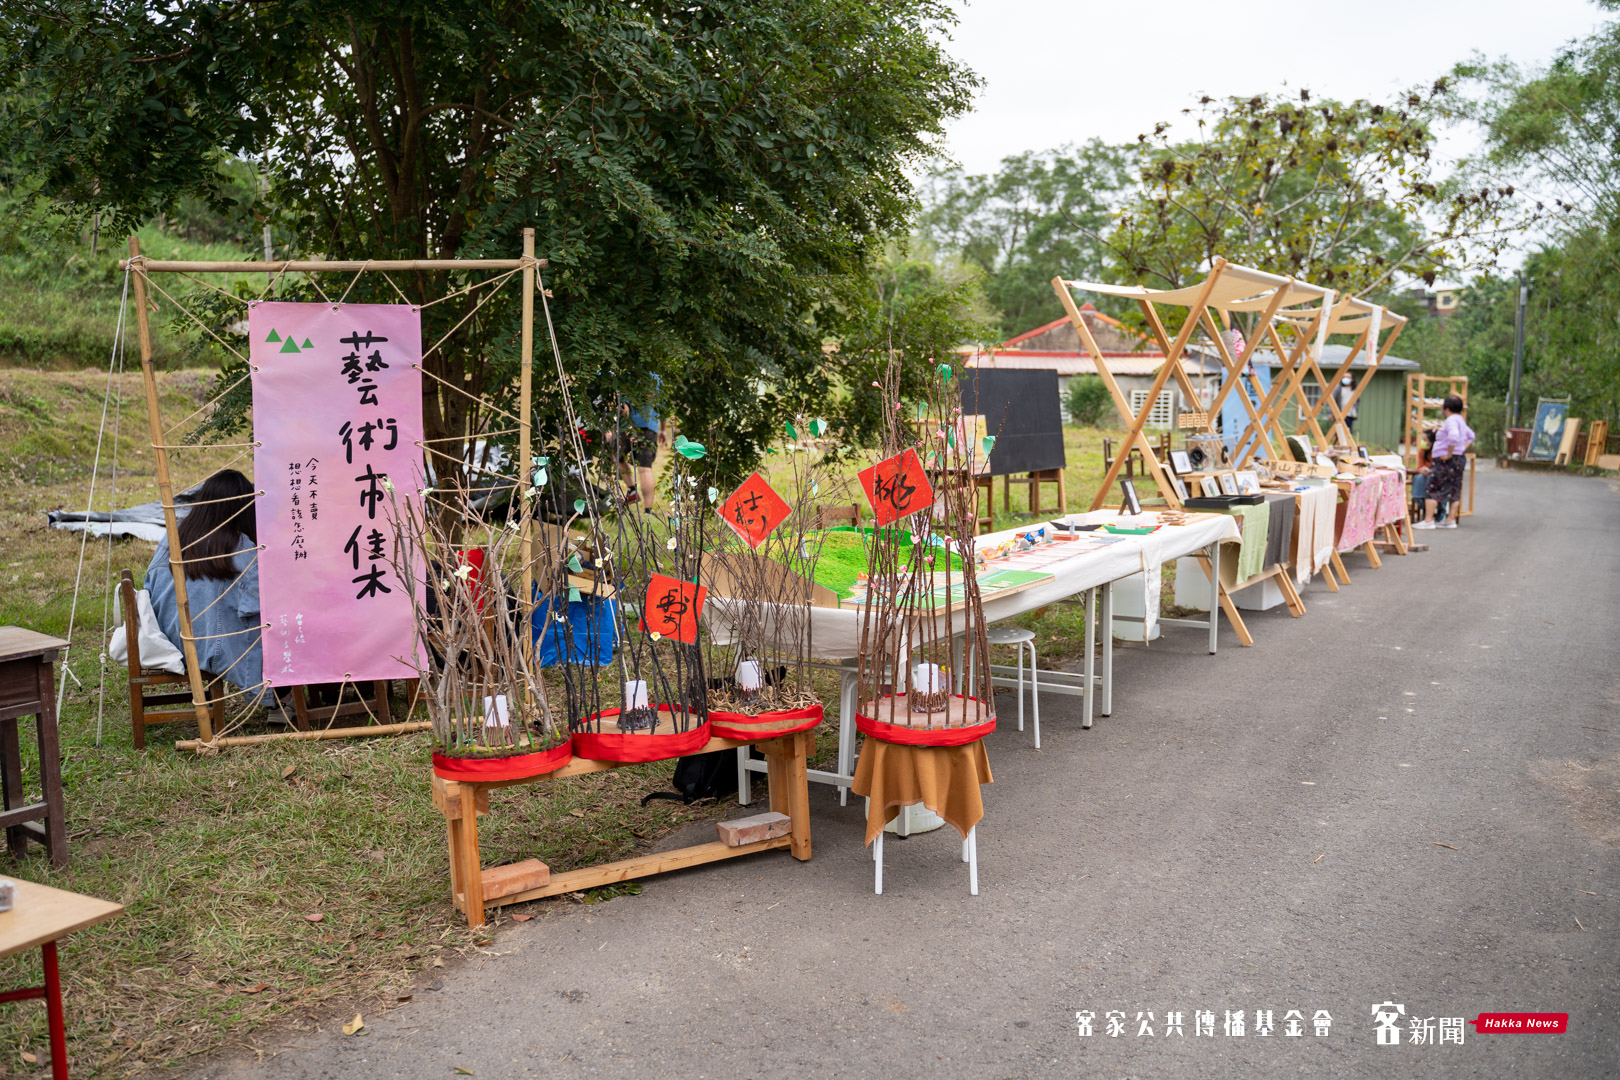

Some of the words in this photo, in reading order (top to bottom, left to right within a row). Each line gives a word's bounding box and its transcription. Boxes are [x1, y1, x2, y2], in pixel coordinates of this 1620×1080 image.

[288, 462, 308, 561] 想想看該怎麼辦
[305, 457, 320, 520] 今天不賣
[339, 330, 398, 600] 藝術市集
